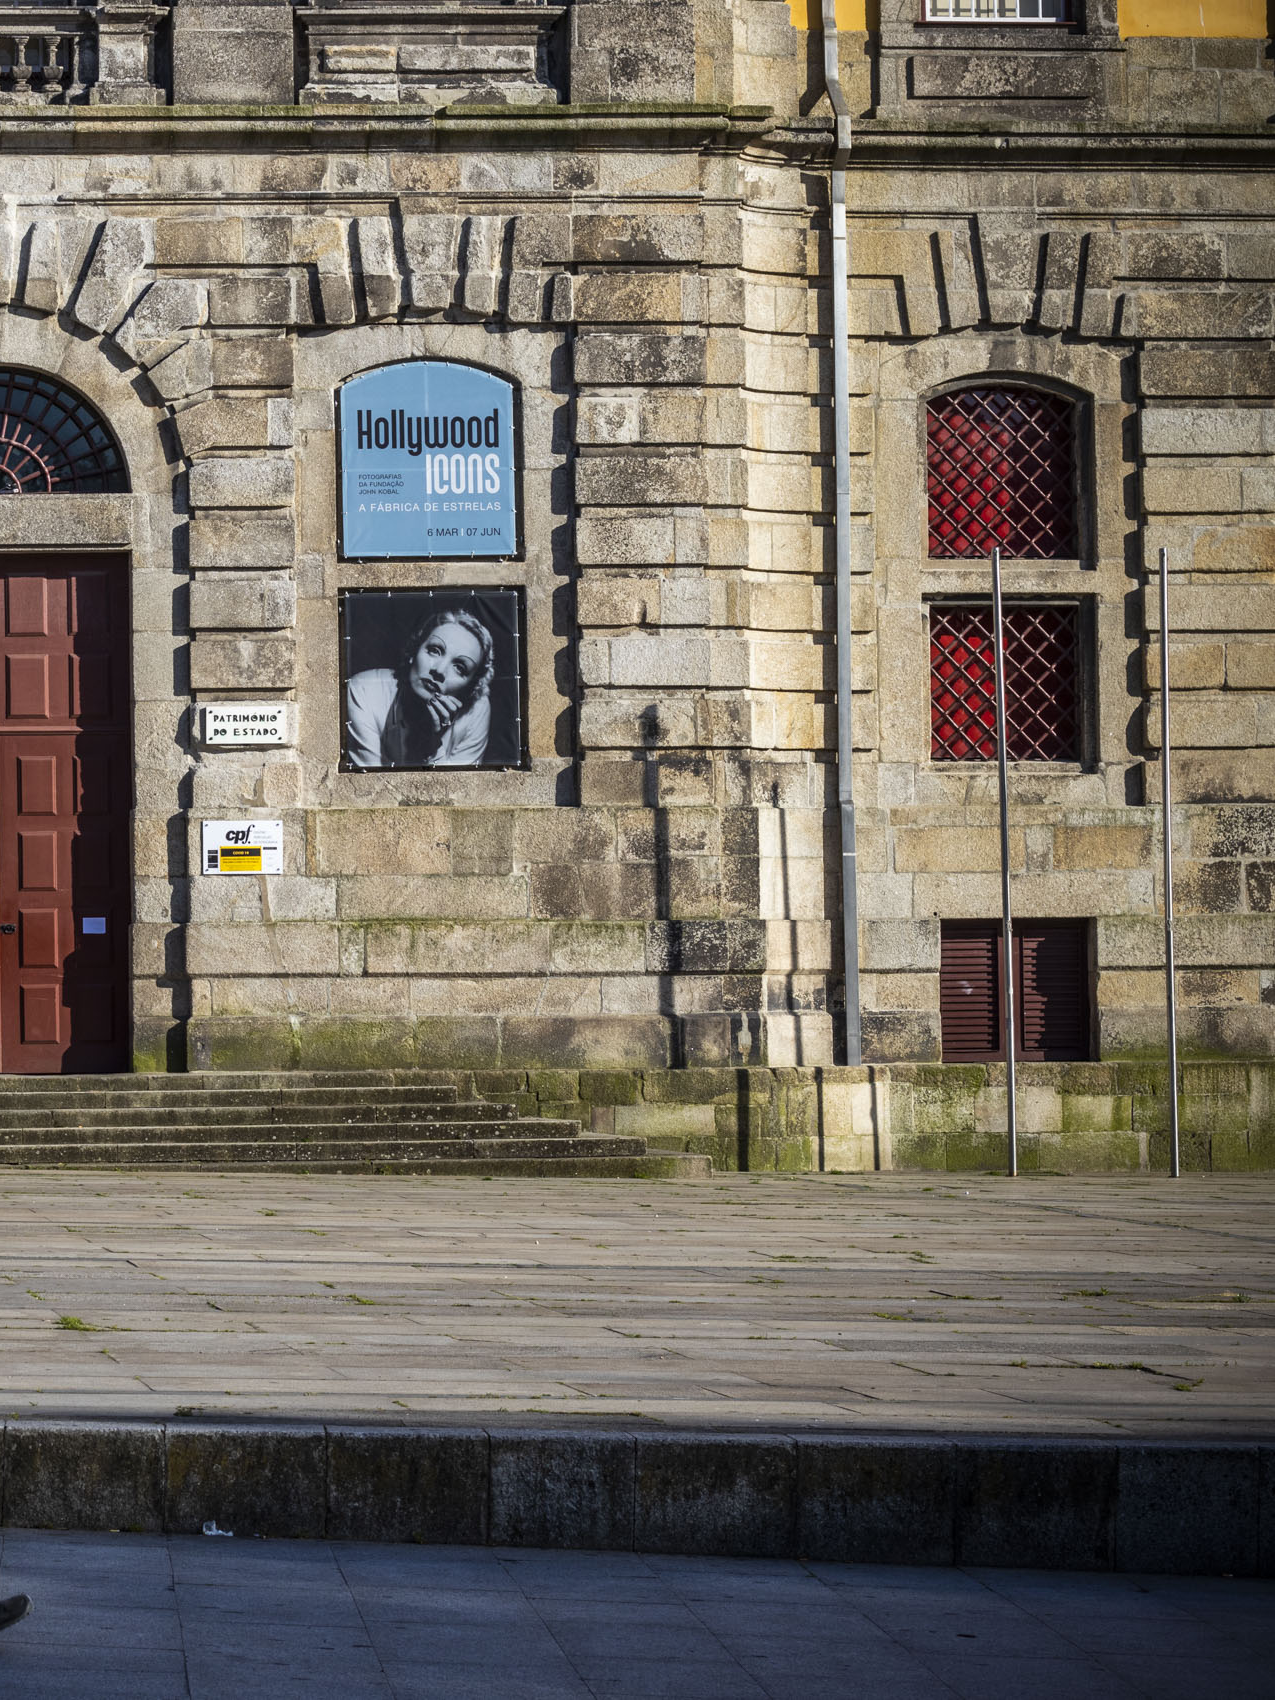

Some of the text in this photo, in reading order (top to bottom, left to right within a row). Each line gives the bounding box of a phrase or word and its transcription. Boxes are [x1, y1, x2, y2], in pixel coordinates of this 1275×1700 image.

[357, 408, 499, 456] Hollywood
[359, 502, 501, 512] A FÁBRICA DE ESTRELAS
[427, 528, 433, 536] 6
[436, 528, 458, 536] MAR
[467, 528, 477, 536] 07
[481, 528, 500, 536] JUN
[214, 713, 277, 722] PATRIMÓNIO
[214, 728, 277, 736] DO ESTADO
